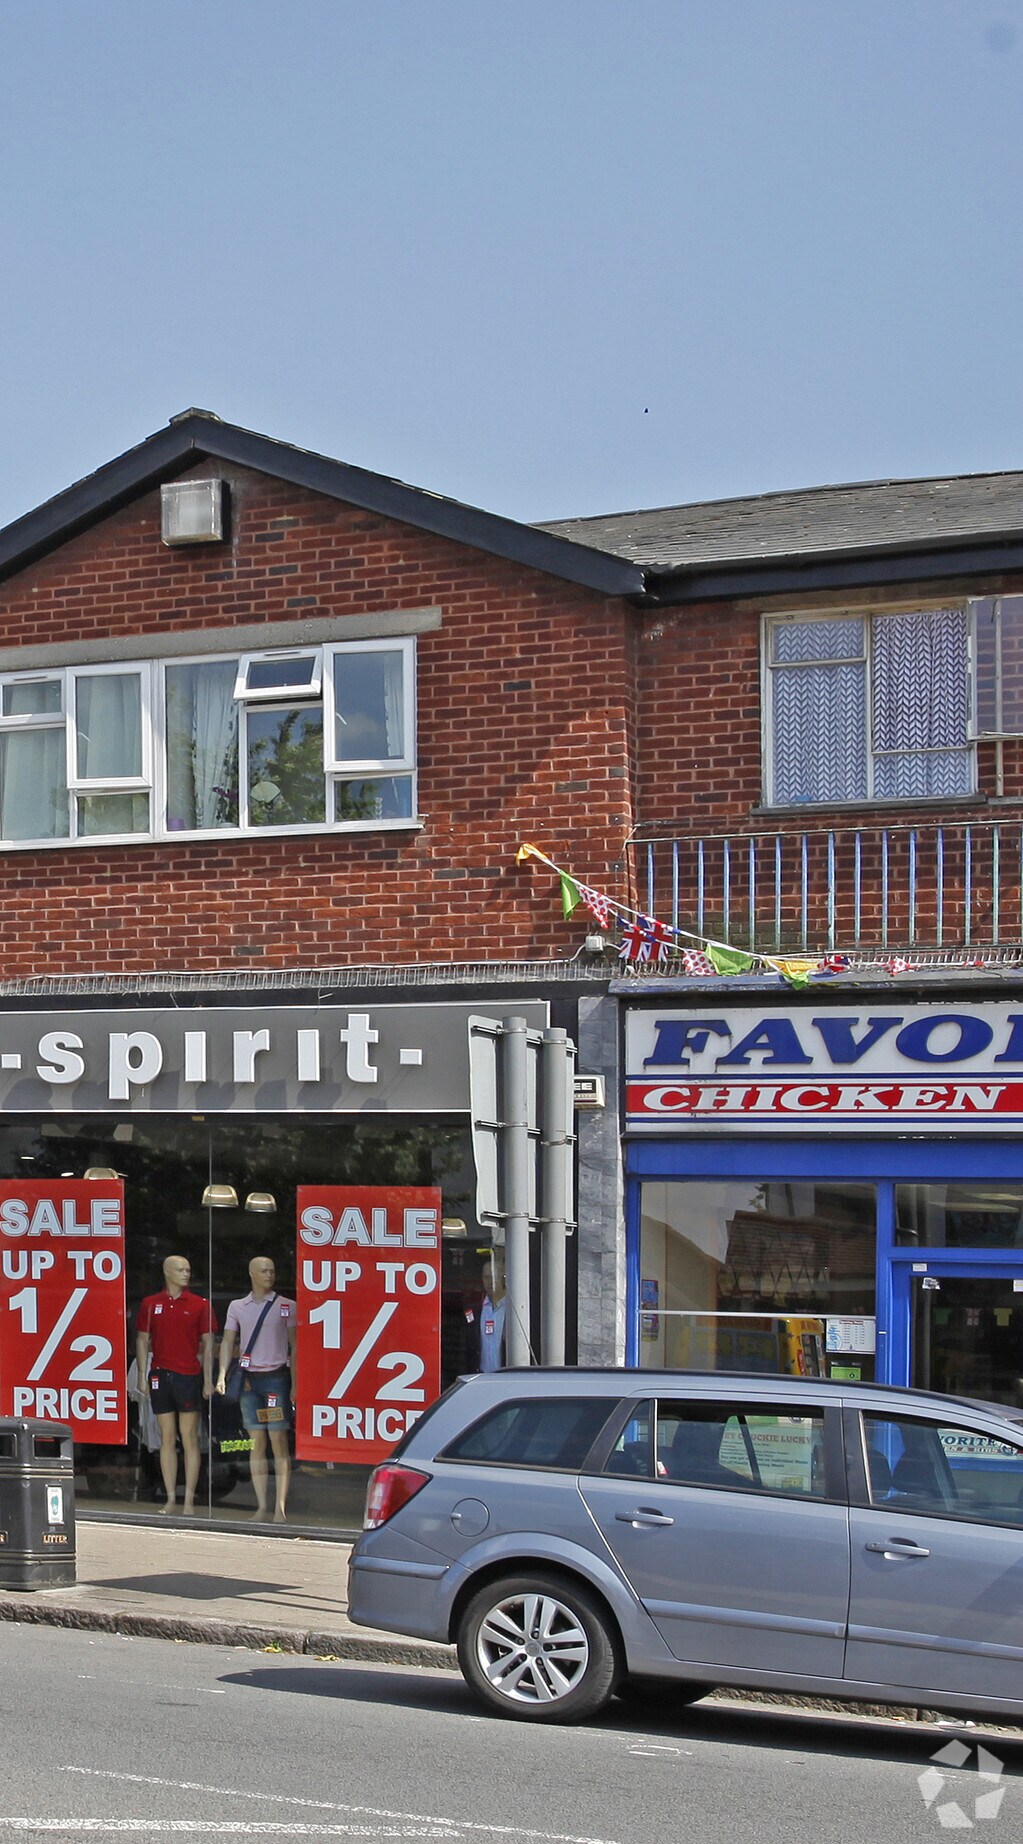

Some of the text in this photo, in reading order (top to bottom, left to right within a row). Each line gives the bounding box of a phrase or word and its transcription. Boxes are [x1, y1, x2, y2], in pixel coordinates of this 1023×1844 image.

[643, 1086, 1006, 1111] CHICKEN
[0, 1198, 122, 1237] SALE
[300, 1206, 438, 1248] SALE
[2, 1250, 122, 1281] UP TO
[303, 1260, 437, 1295] UP TO
[8, 1287, 113, 1383] 1/2
[309, 1300, 425, 1402] 1/2
[13, 1386, 118, 1421] PRICE
[43, 1534, 68, 1544] LITTER
